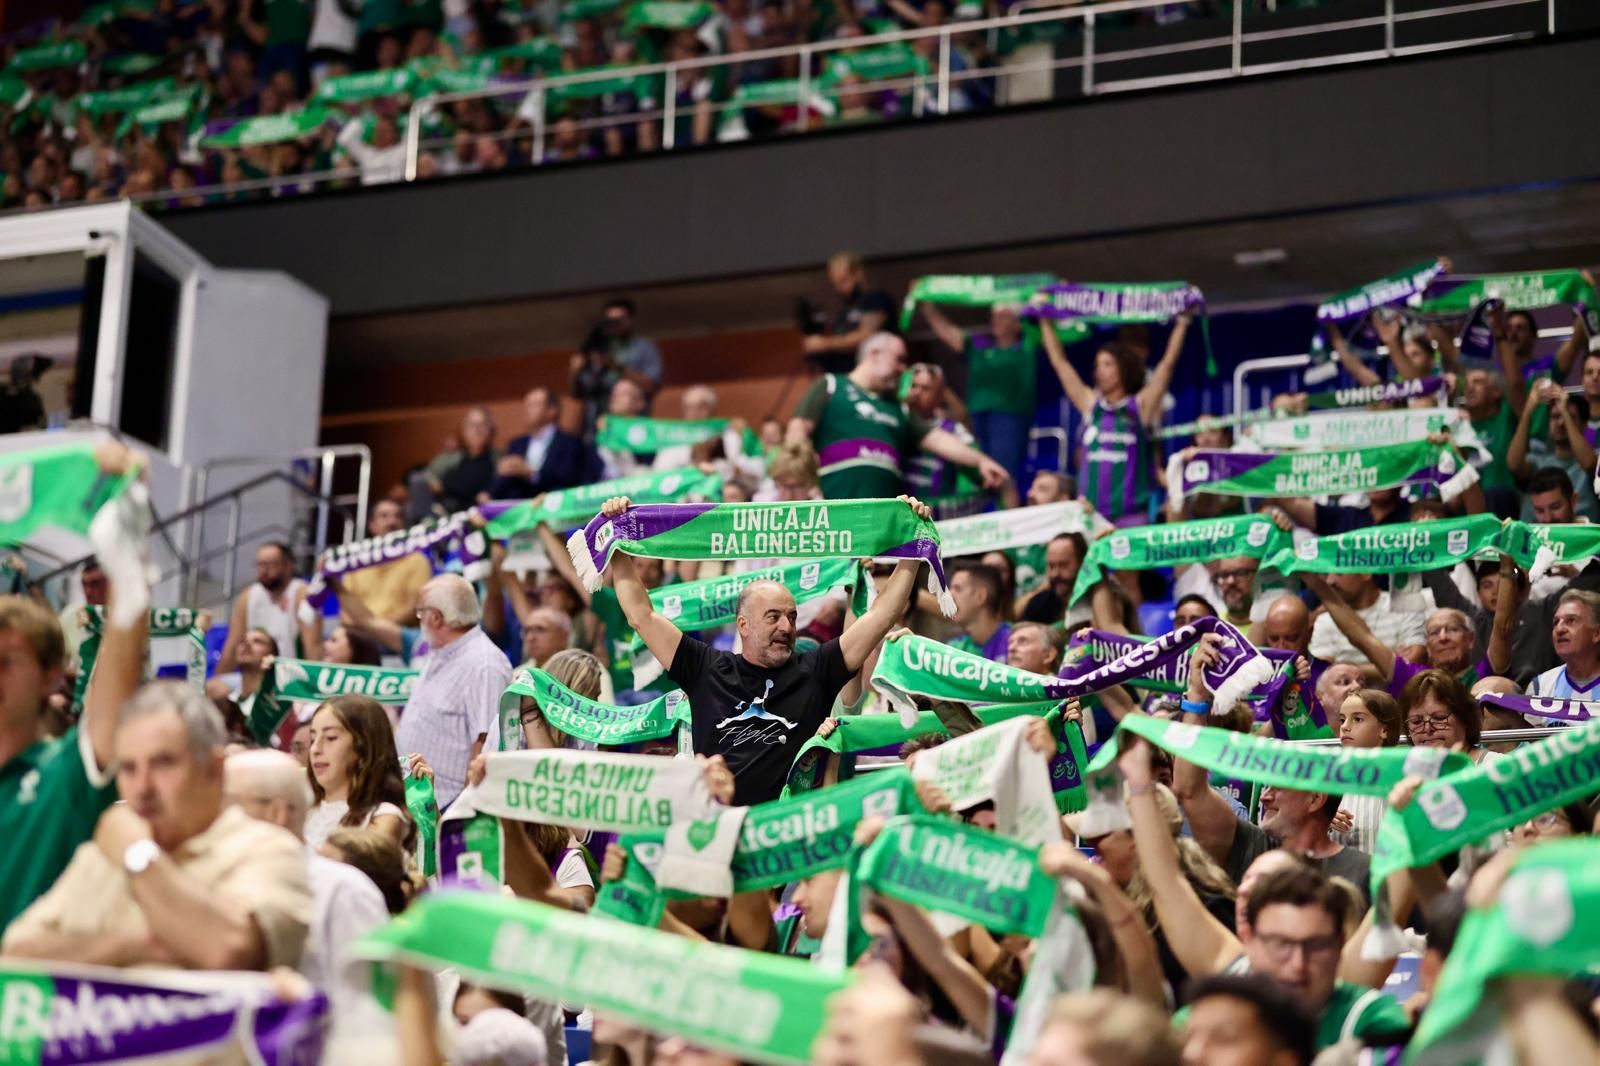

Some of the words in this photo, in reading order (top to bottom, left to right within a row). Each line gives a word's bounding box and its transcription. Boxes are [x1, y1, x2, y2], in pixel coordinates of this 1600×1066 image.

[1335, 378, 1423, 405] UNICAJA
[1291, 451, 1362, 474] UNICAJA
[1275, 465, 1377, 492] BALONCESTO
[733, 506, 830, 531] UNICAJA
[711, 530, 852, 555] BALONCESTO
[1145, 521, 1235, 546] Unicaja
[1337, 527, 1430, 552] Unicaja
[700, 568, 785, 601] Unica
[902, 638, 1009, 691] Unicaja
[317, 667, 414, 695] Unica
[546, 701, 646, 740] Unicaja
[1485, 718, 1600, 784] Unic
[739, 802, 838, 853] icaja
[898, 824, 1032, 892] Unicaja
